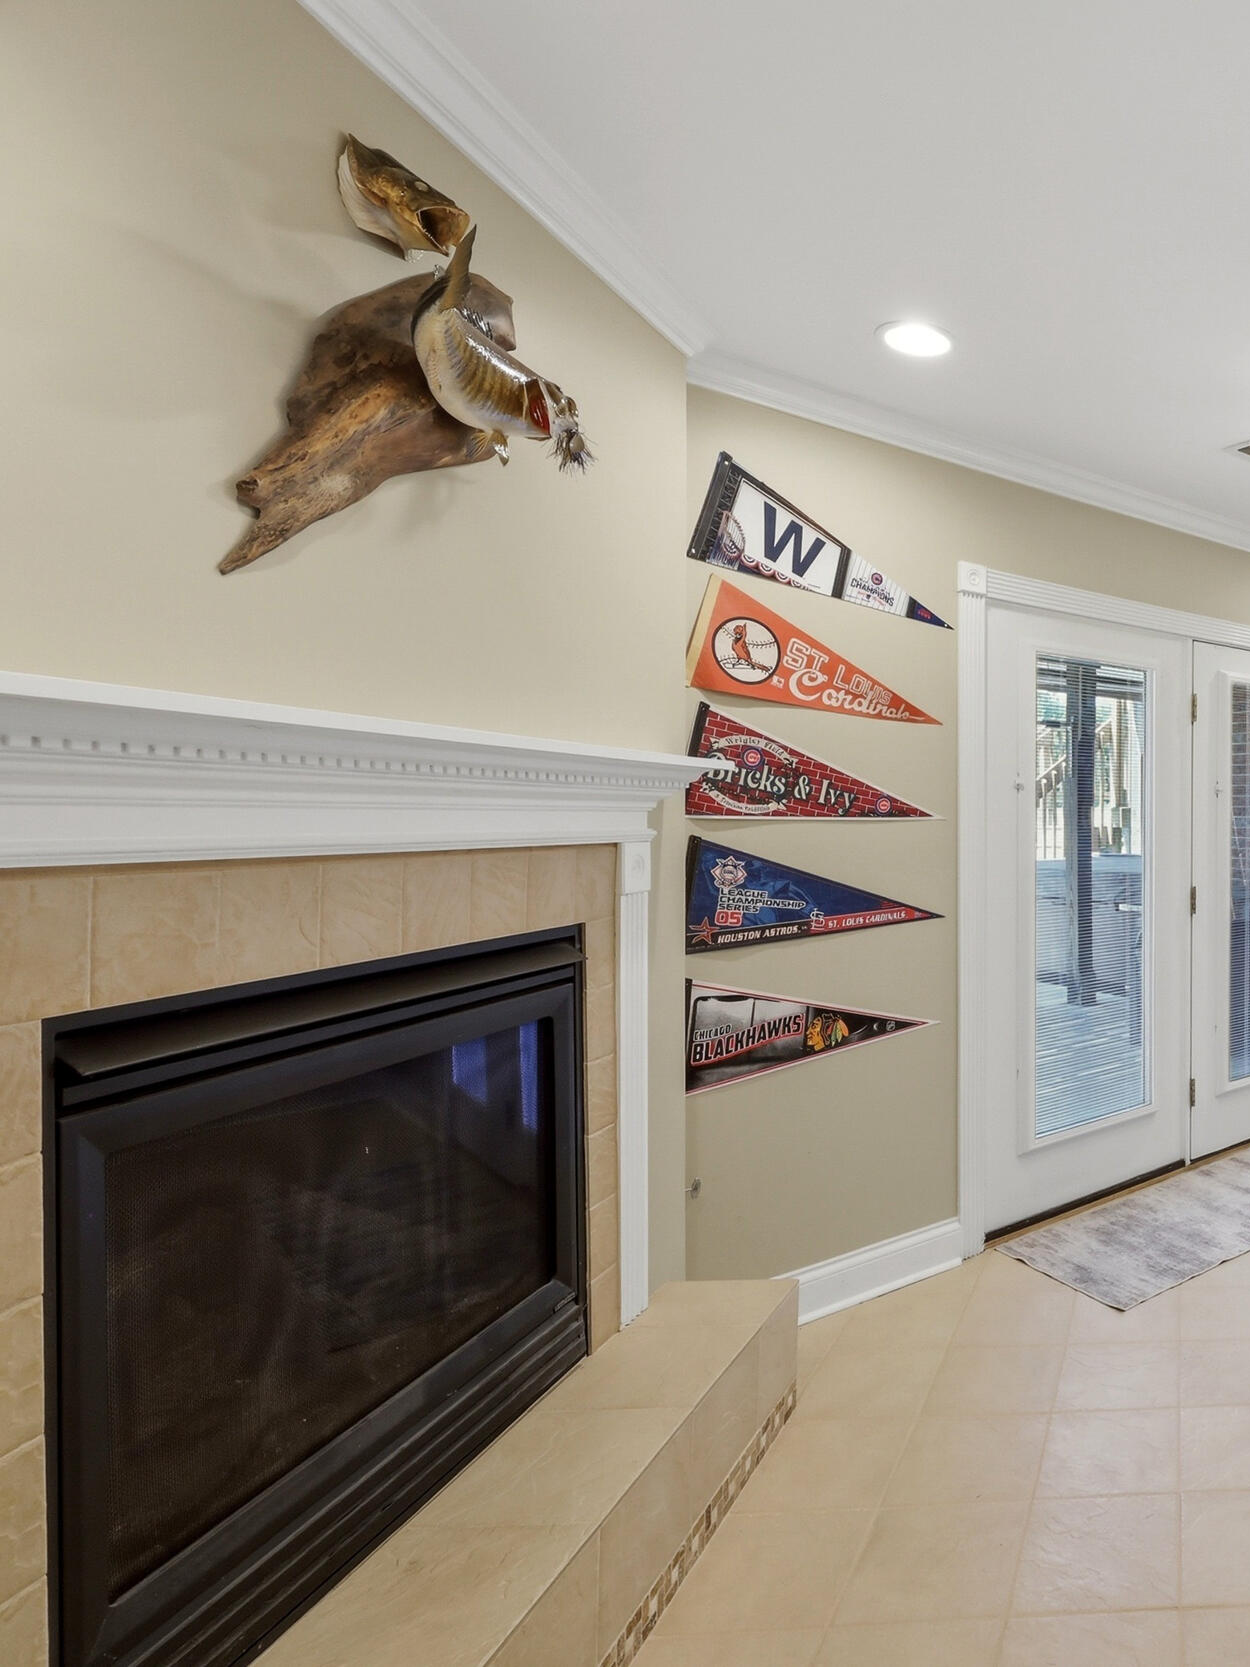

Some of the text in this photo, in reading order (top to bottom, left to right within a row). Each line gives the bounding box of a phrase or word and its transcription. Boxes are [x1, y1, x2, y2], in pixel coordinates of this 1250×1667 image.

[763, 500, 827, 578] W
[850, 577, 895, 607] CHAMPIONS
[783, 637, 829, 678] ST
[833, 664, 893, 705] LOUIS
[789, 669, 925, 721] Cardinals
[794, 775, 812, 800] &
[817, 778, 856, 816] Ivy
[719, 896, 806, 909] CHAMPIONSHIP
[720, 888, 767, 899] LEAGUE
[715, 909, 743, 926] 05
[718, 903, 760, 914] SERIES
[842, 915, 864, 927] LOUIS
[866, 910, 906, 924] CARDINALS
[717, 929, 761, 945] HOUSTON
[690, 1014, 804, 1066] BLACKHAWKS
[694, 1023, 732, 1042] CHICAGO
